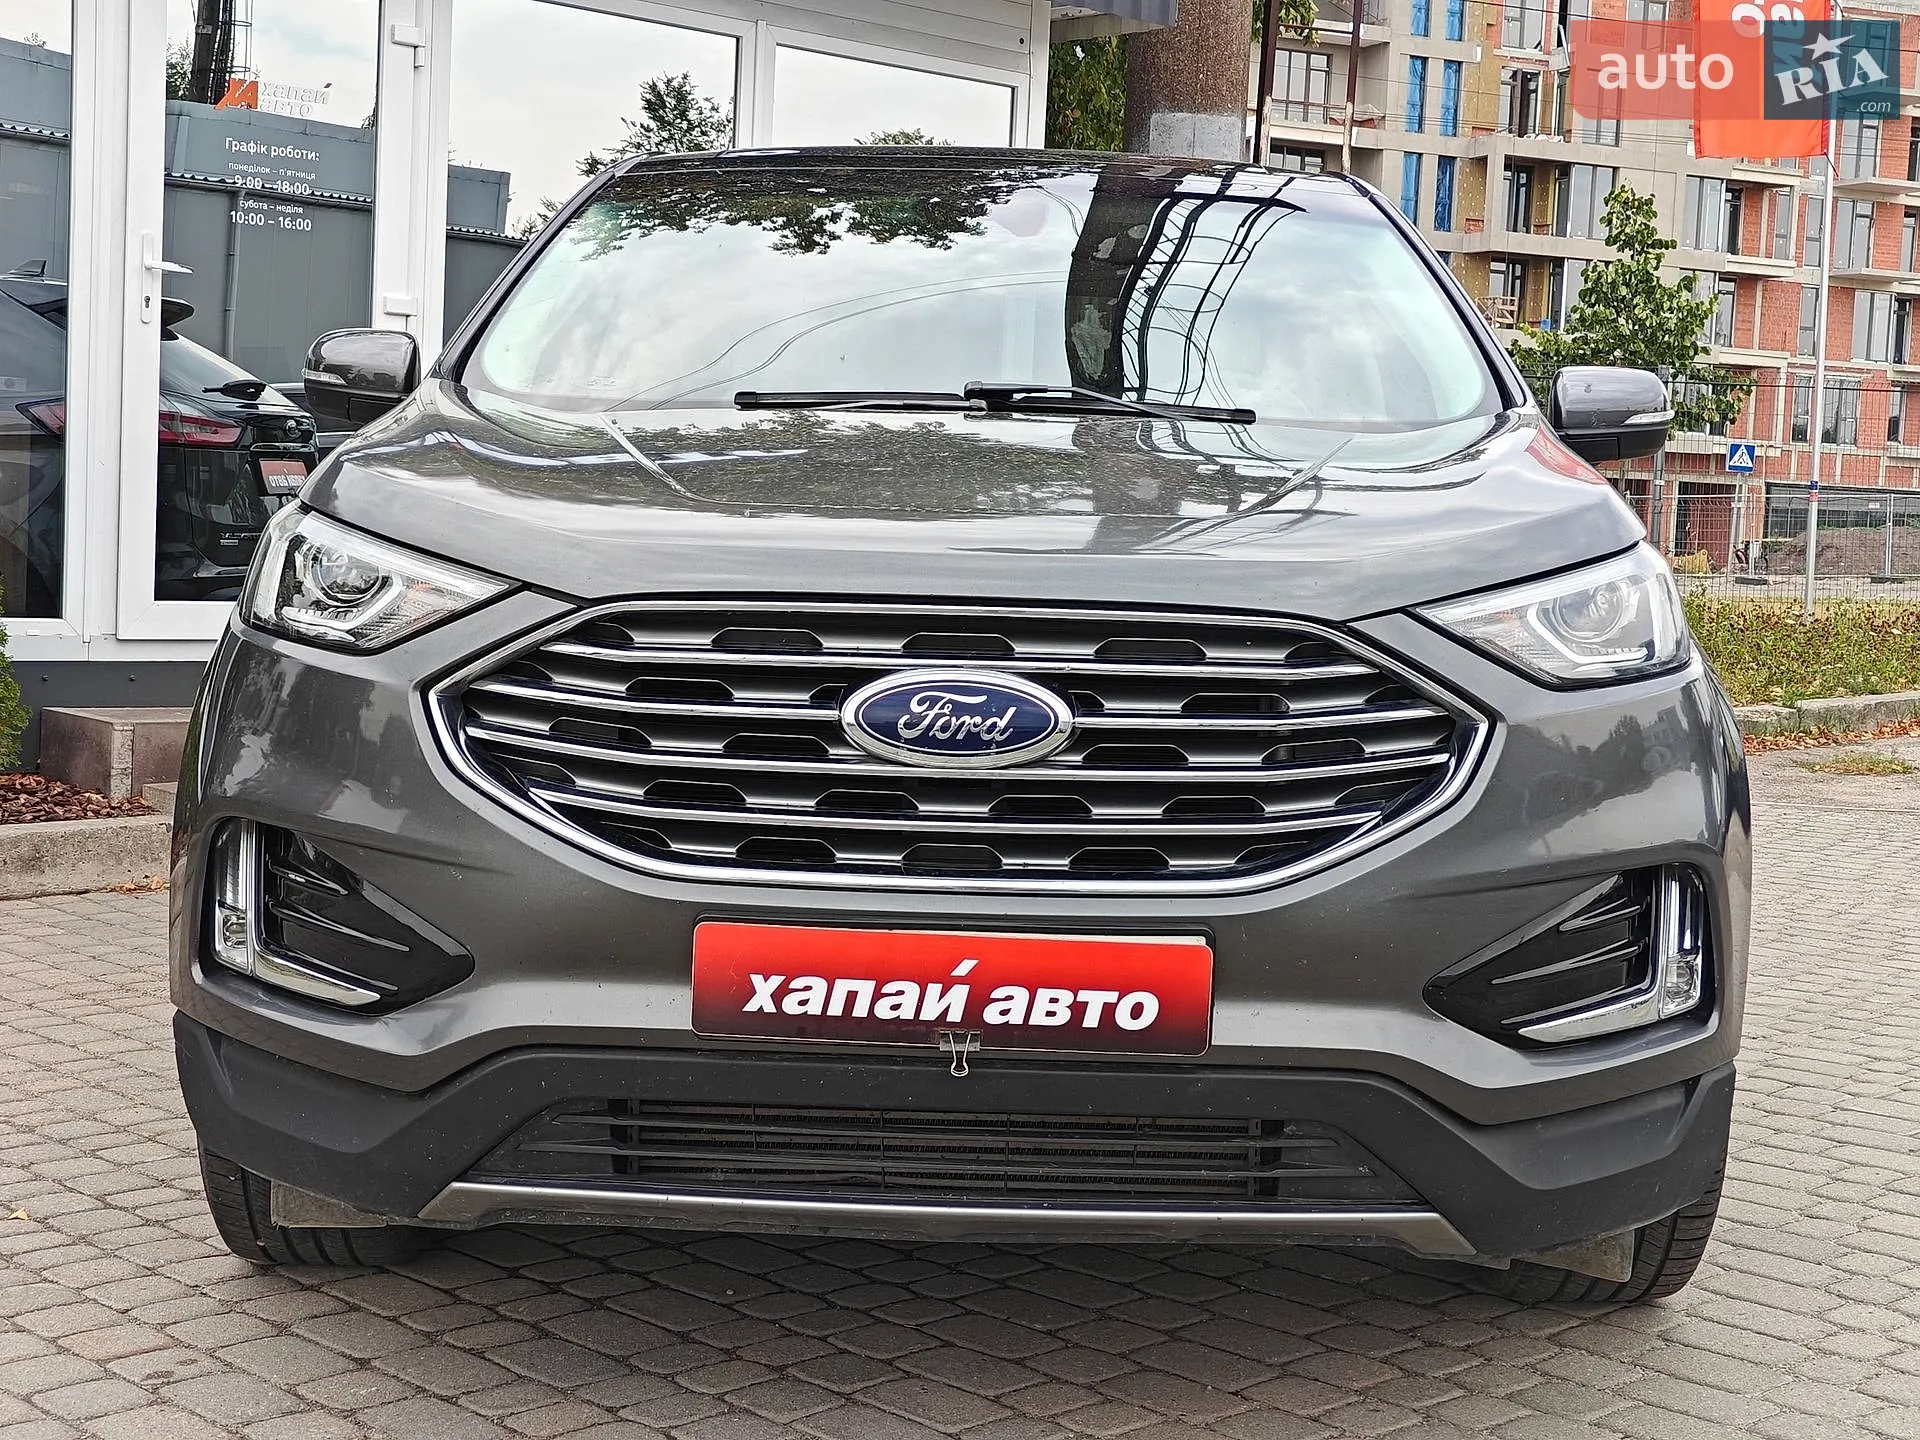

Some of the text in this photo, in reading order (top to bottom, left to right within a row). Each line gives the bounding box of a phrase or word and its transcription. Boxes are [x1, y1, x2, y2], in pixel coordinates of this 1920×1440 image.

[260, 99, 314, 117] авто
[225, 137, 321, 162] Графік роботи:
[228, 162, 271, 175] понеділок
[279, 167, 316, 181] п'ятниця
[234, 174, 263, 190] 9:00
[276, 179, 310, 196] 18:00
[239, 199, 268, 210] субота
[276, 203, 304, 215] неділя
[230, 210, 265, 226] 10:00
[278, 216, 312, 232] 16:00
[897, 691, 1017, 741] Ford
[742, 959, 1159, 1031] хапай авто
